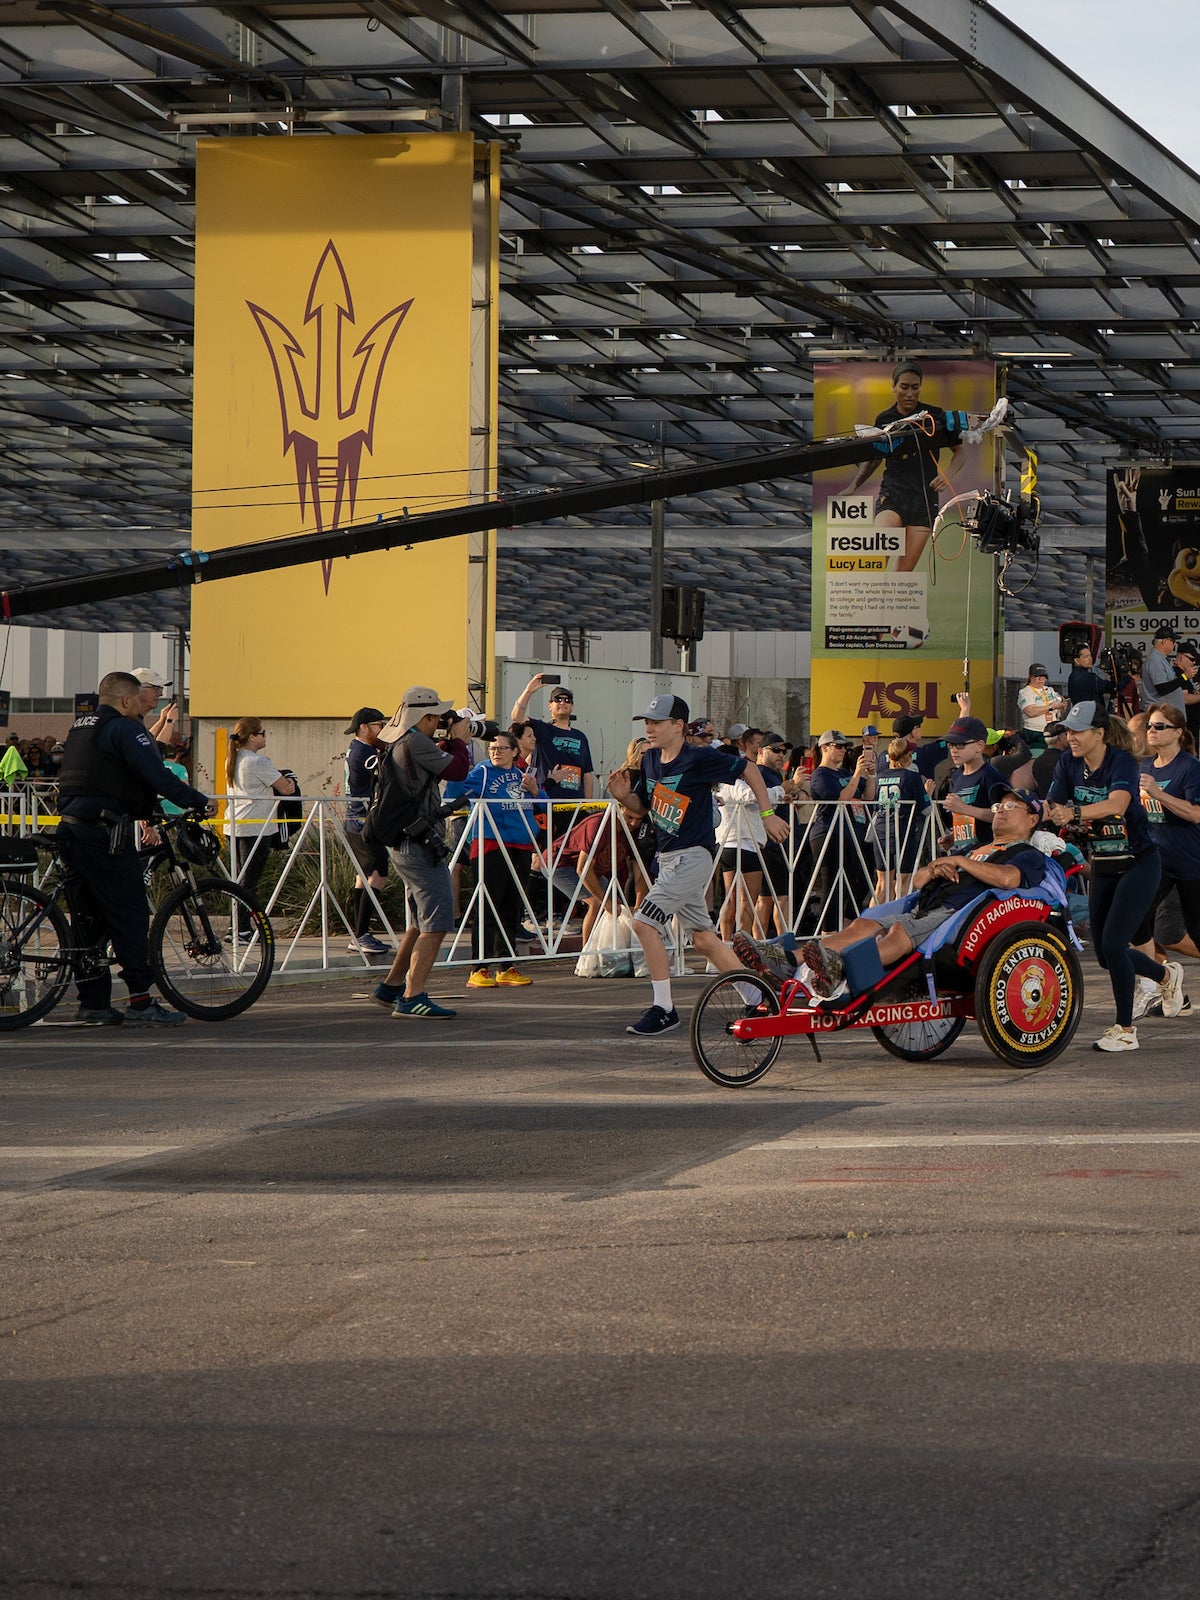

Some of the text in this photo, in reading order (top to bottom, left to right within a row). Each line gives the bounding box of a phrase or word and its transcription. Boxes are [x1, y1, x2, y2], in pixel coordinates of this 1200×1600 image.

[1176, 488, 1196, 497] Sun
[832, 501, 867, 518] Net
[831, 533, 900, 550] results
[830, 559, 882, 570] Lucy Lara
[1114, 616, 1199, 631] It's good to
[1138, 641, 1146, 650] a
[857, 682, 940, 719] ASU
[74, 716, 99, 728] OLICE
[490, 772, 519, 794] UNIVER
[653, 795, 684, 825] 11012
[953, 824, 974, 841] 19617
[1103, 825, 1127, 836] 013
[965, 918, 987, 952] HOYT
[996, 946, 1044, 1024] MARINE CORPS
[1020, 963, 1068, 1044] UNITED STATES
